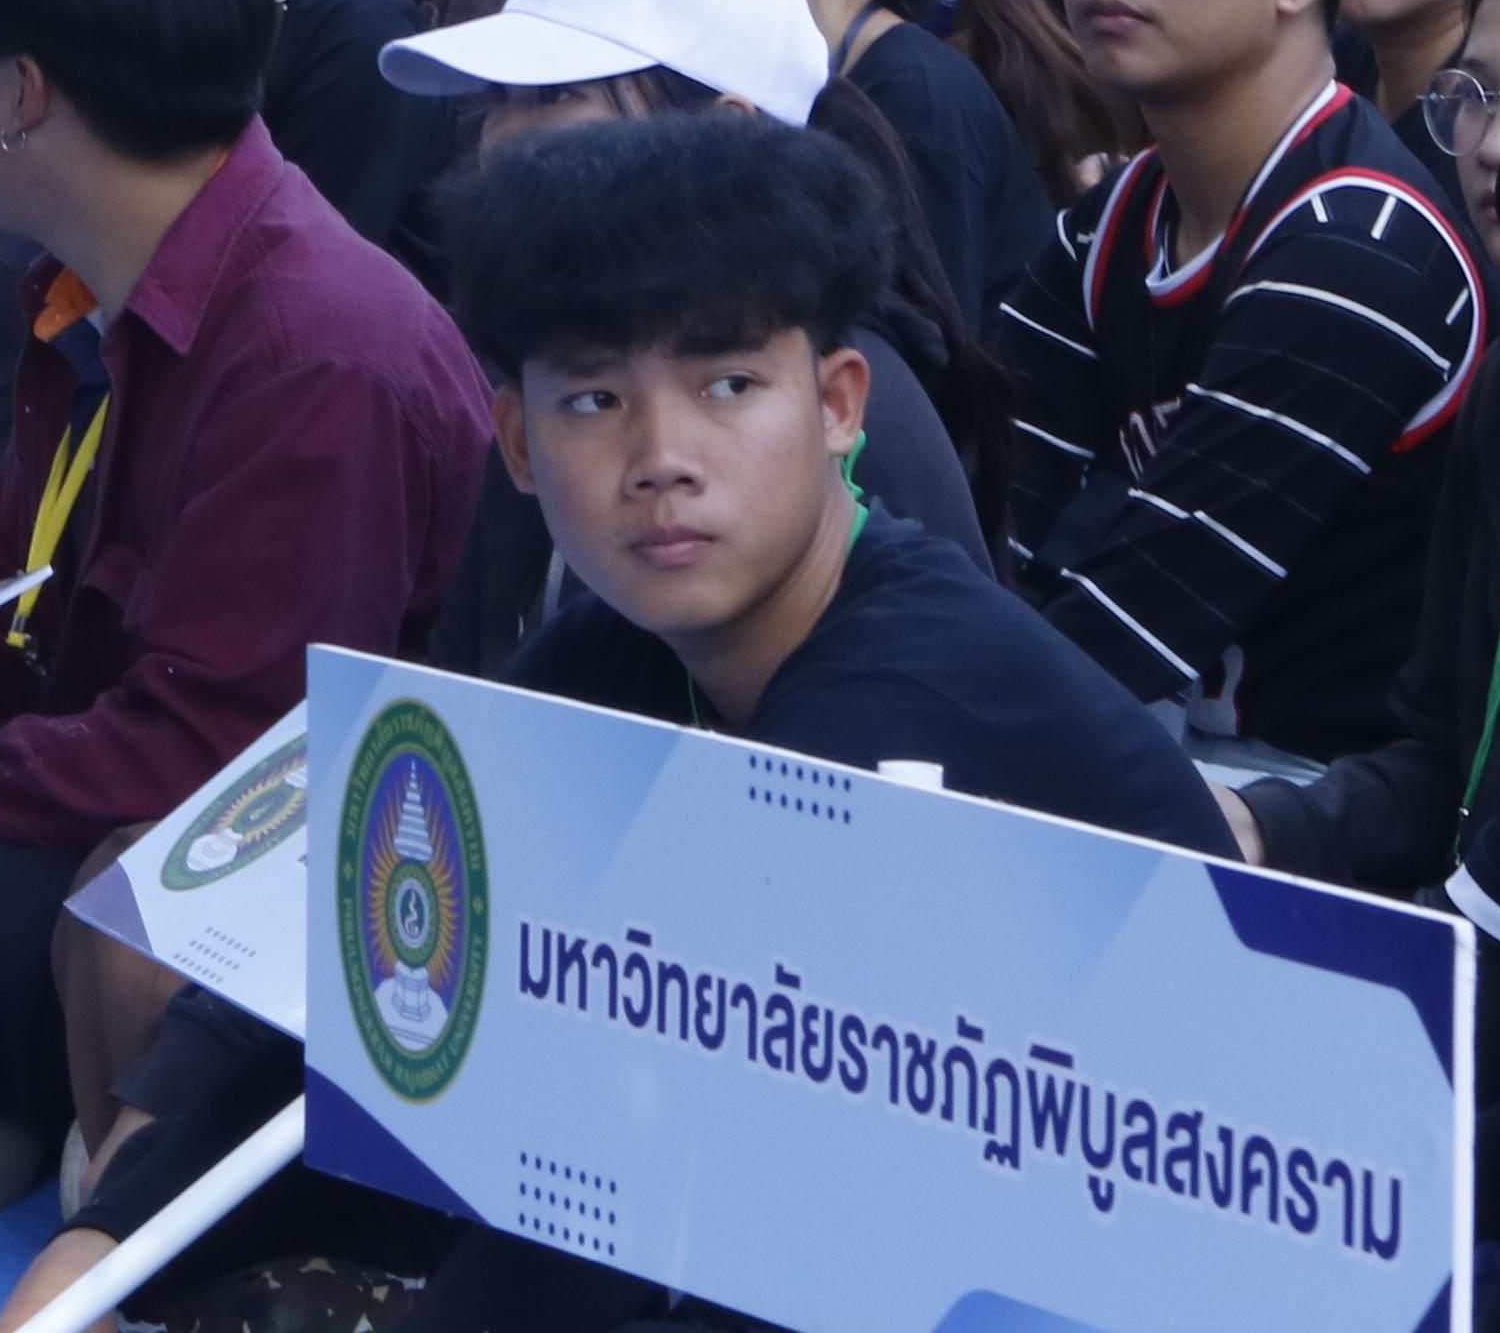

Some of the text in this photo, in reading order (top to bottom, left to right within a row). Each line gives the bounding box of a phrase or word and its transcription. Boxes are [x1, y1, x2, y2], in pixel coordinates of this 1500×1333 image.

[517, 919, 1403, 1262] มหาวิทยาลัยราชภัฏพิบูลสงคราม
